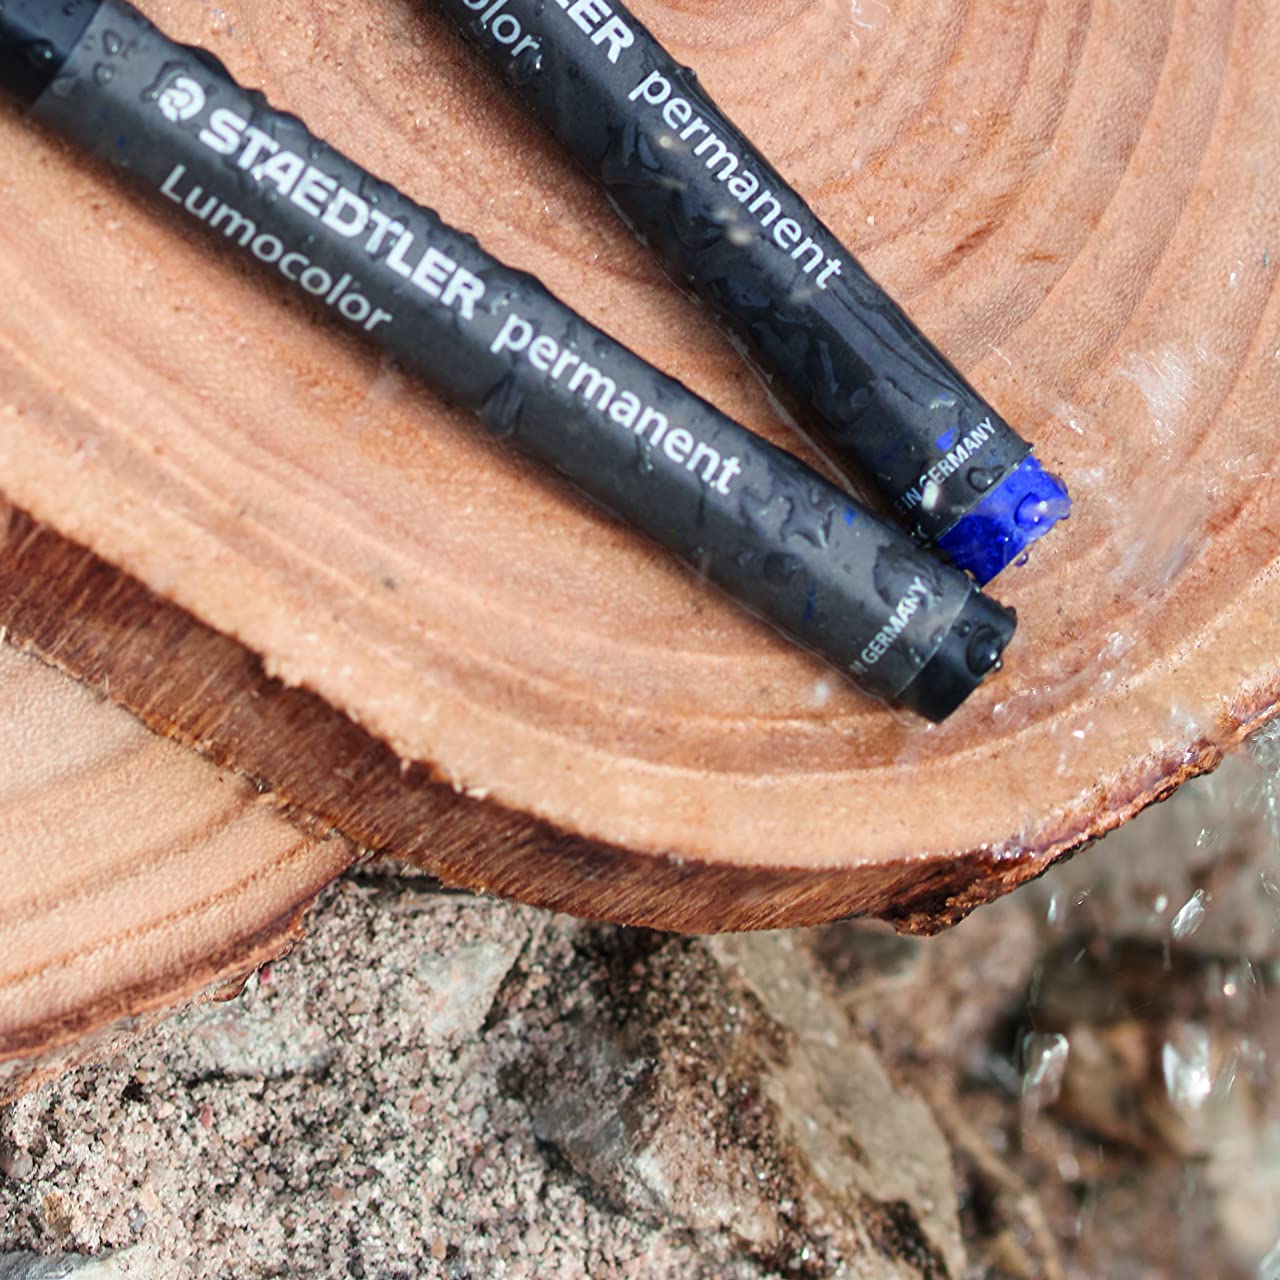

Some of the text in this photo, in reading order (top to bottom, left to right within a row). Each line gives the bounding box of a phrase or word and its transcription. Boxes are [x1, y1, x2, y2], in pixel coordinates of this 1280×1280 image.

[159, 164, 393, 331] Lumocolor
[627, 70, 842, 290] permanent
[198, 107, 742, 496] STAEDTLER permanent
[860, 575, 928, 665] GERMANY
